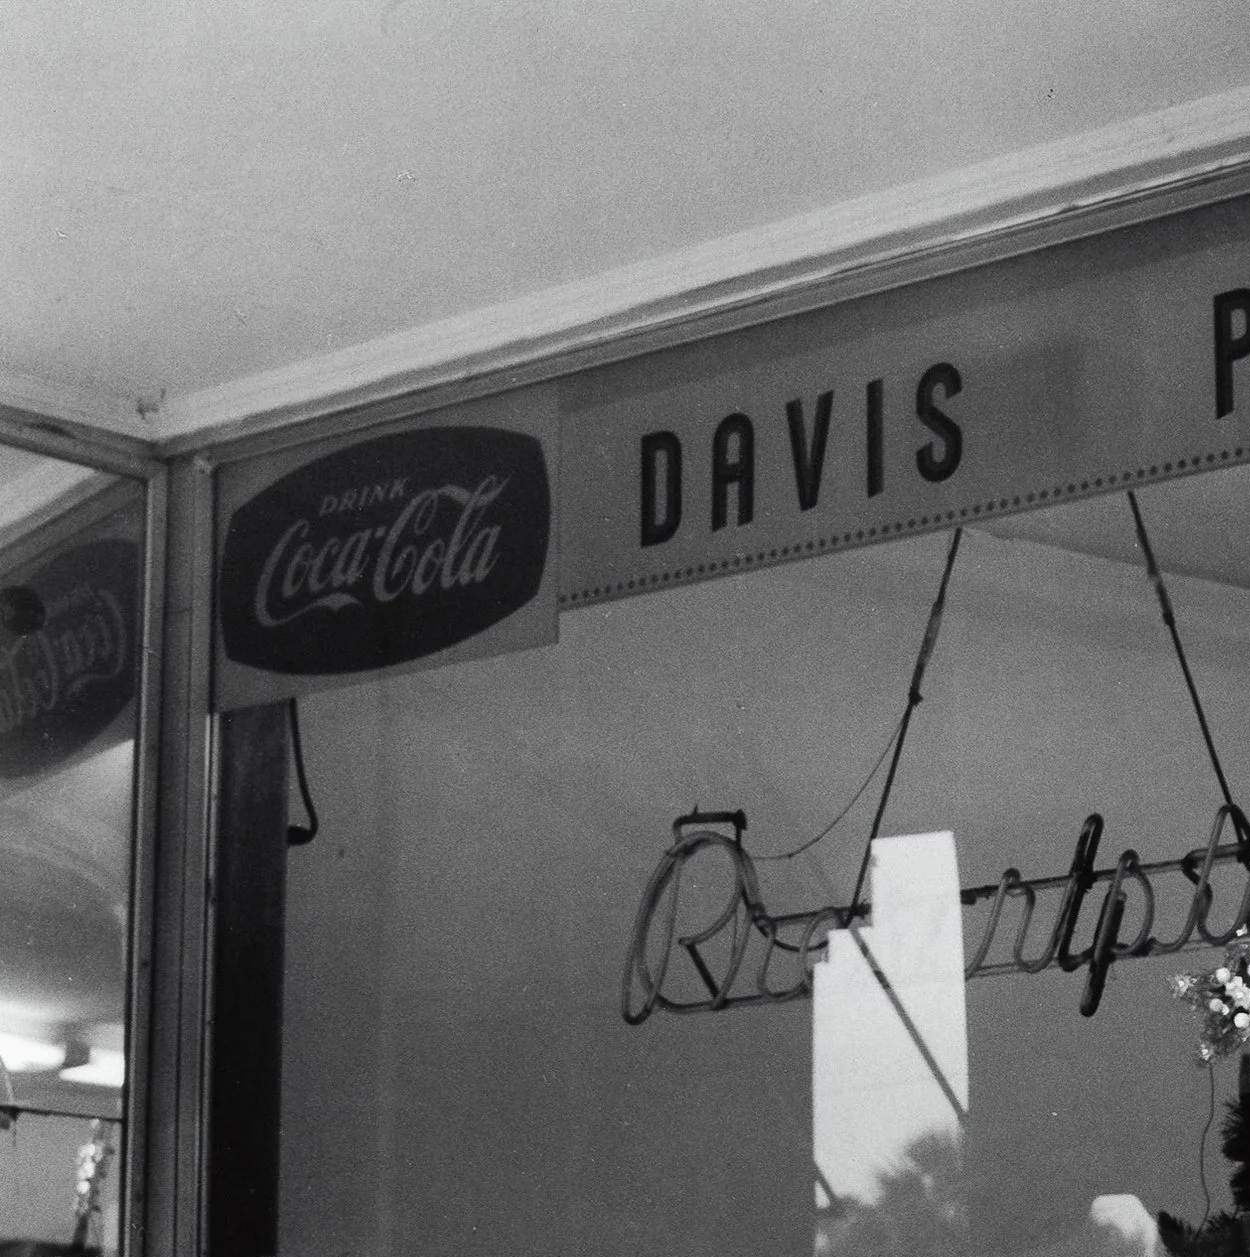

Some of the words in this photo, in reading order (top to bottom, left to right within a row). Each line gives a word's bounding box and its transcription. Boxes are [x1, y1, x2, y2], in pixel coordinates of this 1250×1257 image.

[319, 476, 408, 517] DRINK
[640, 362, 963, 549] DAVIS
[254, 475, 511, 627] Coca-Cola
